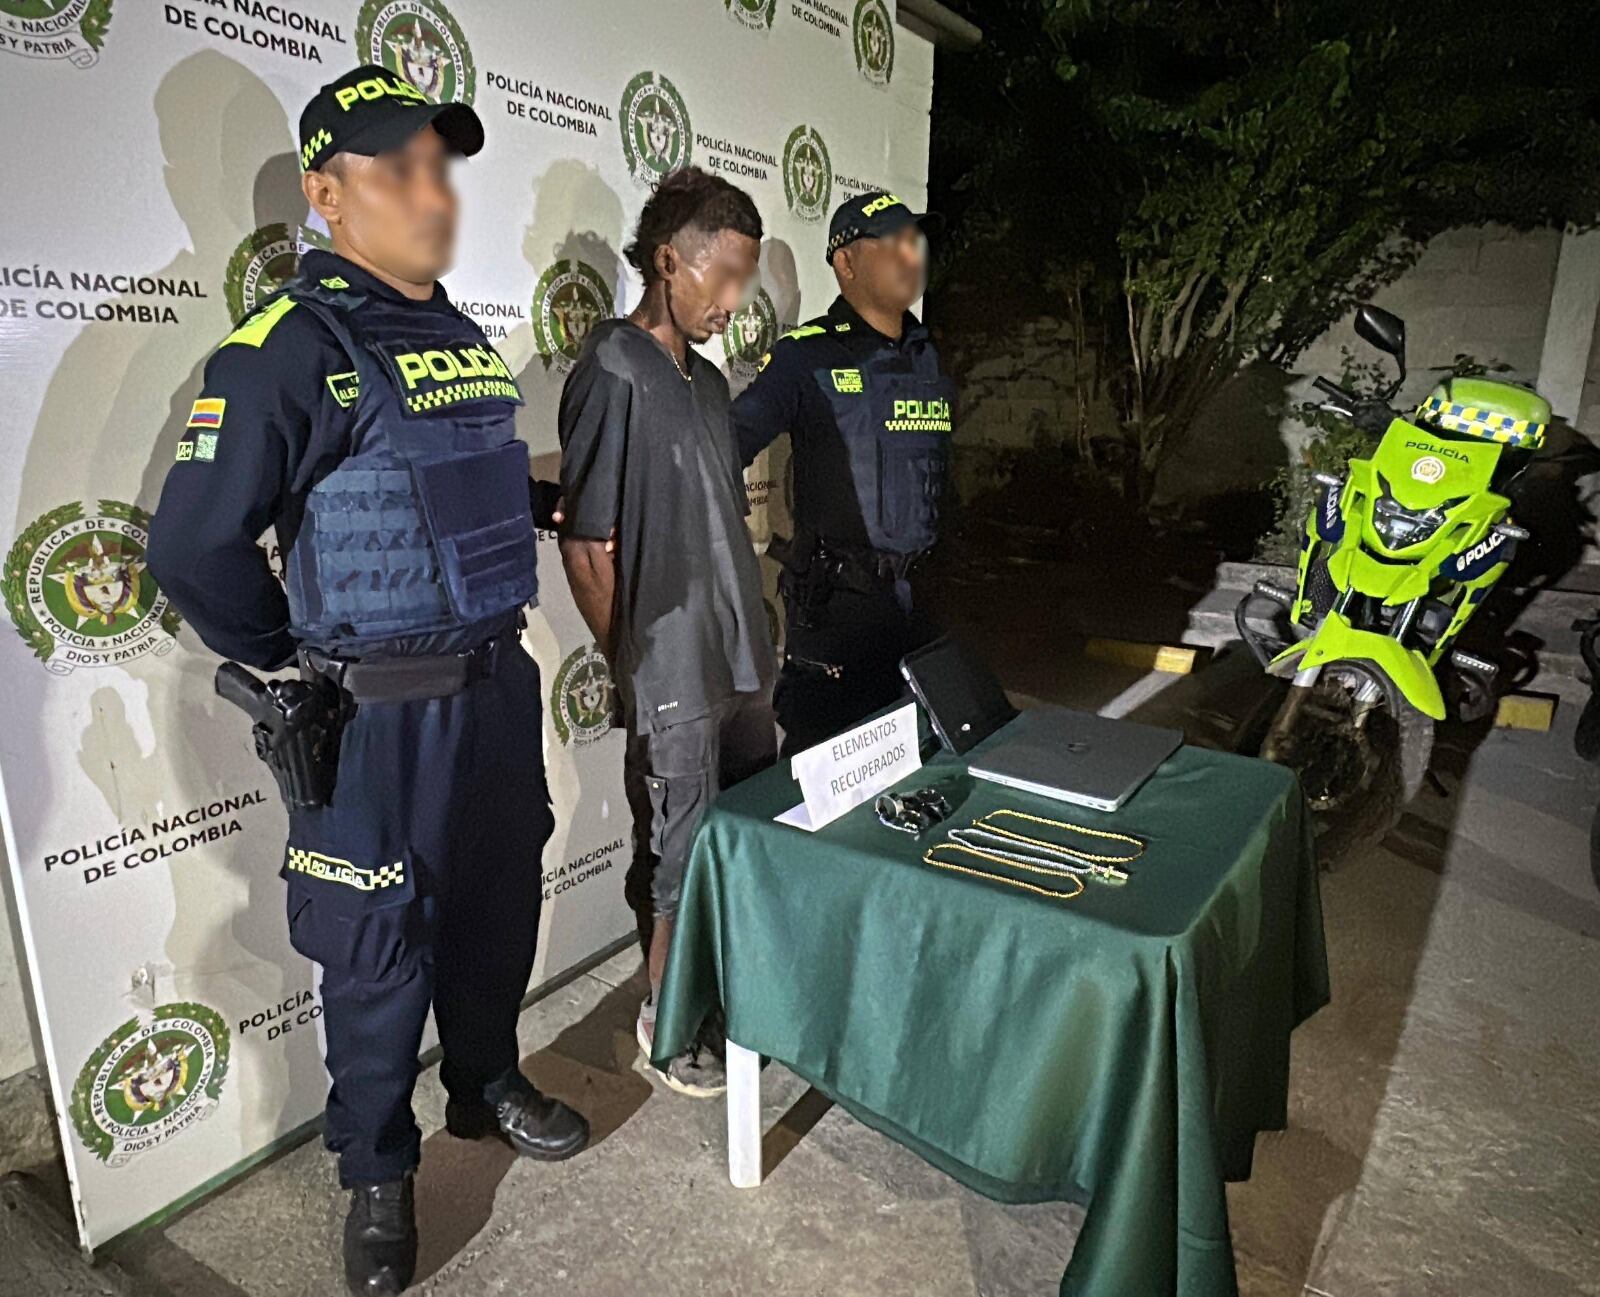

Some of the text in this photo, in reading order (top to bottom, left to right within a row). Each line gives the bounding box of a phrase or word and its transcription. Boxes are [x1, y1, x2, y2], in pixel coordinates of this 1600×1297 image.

[165, 5, 322, 63] DE COLOMBIA
[234, 0, 346, 43] NACIONAL
[792, 4, 841, 38] DE COLOMBIA
[24, 38, 76, 54] PATRIA
[487, 71, 612, 120] POLICÍA NACIONAL
[507, 100, 597, 137] DE COLOMBIA
[697, 133, 778, 167] POLICÍA NACIONAL
[709, 156, 767, 180] DE COLOMBIA
[290, 242, 305, 252] DE
[71, 272, 208, 298] NACIONAL
[36, 300, 180, 324] COLOMBIA
[395, 344, 513, 389] POLICÍA
[894, 397, 950, 420] POLICÍA
[1405, 441, 1470, 464] POLICIA
[29, 529, 72, 604] REPUBLICA
[86, 519, 105, 529] DE
[113, 598, 167, 645] NACIONAL
[66, 636, 157, 664] DIOS Y PATRIA
[832, 719, 897, 761] ELEMENTOS
[831, 743, 906, 796] RECUPERADOS
[44, 790, 267, 871] POLICÍA NACIONAL
[84, 819, 242, 884] DE COLOMBIA
[542, 839, 625, 884] ICÍA NACIONAL
[554, 860, 612, 895] COLOMBIA
[239, 991, 314, 1034] POLICÍA
[268, 1020, 292, 1040] DE
[93, 1020, 213, 1115] REPUBLICA DE COLOMBIA
[163, 1074, 211, 1125] NACIONAL
[124, 1106, 202, 1151] DIOS Y PATRIA
